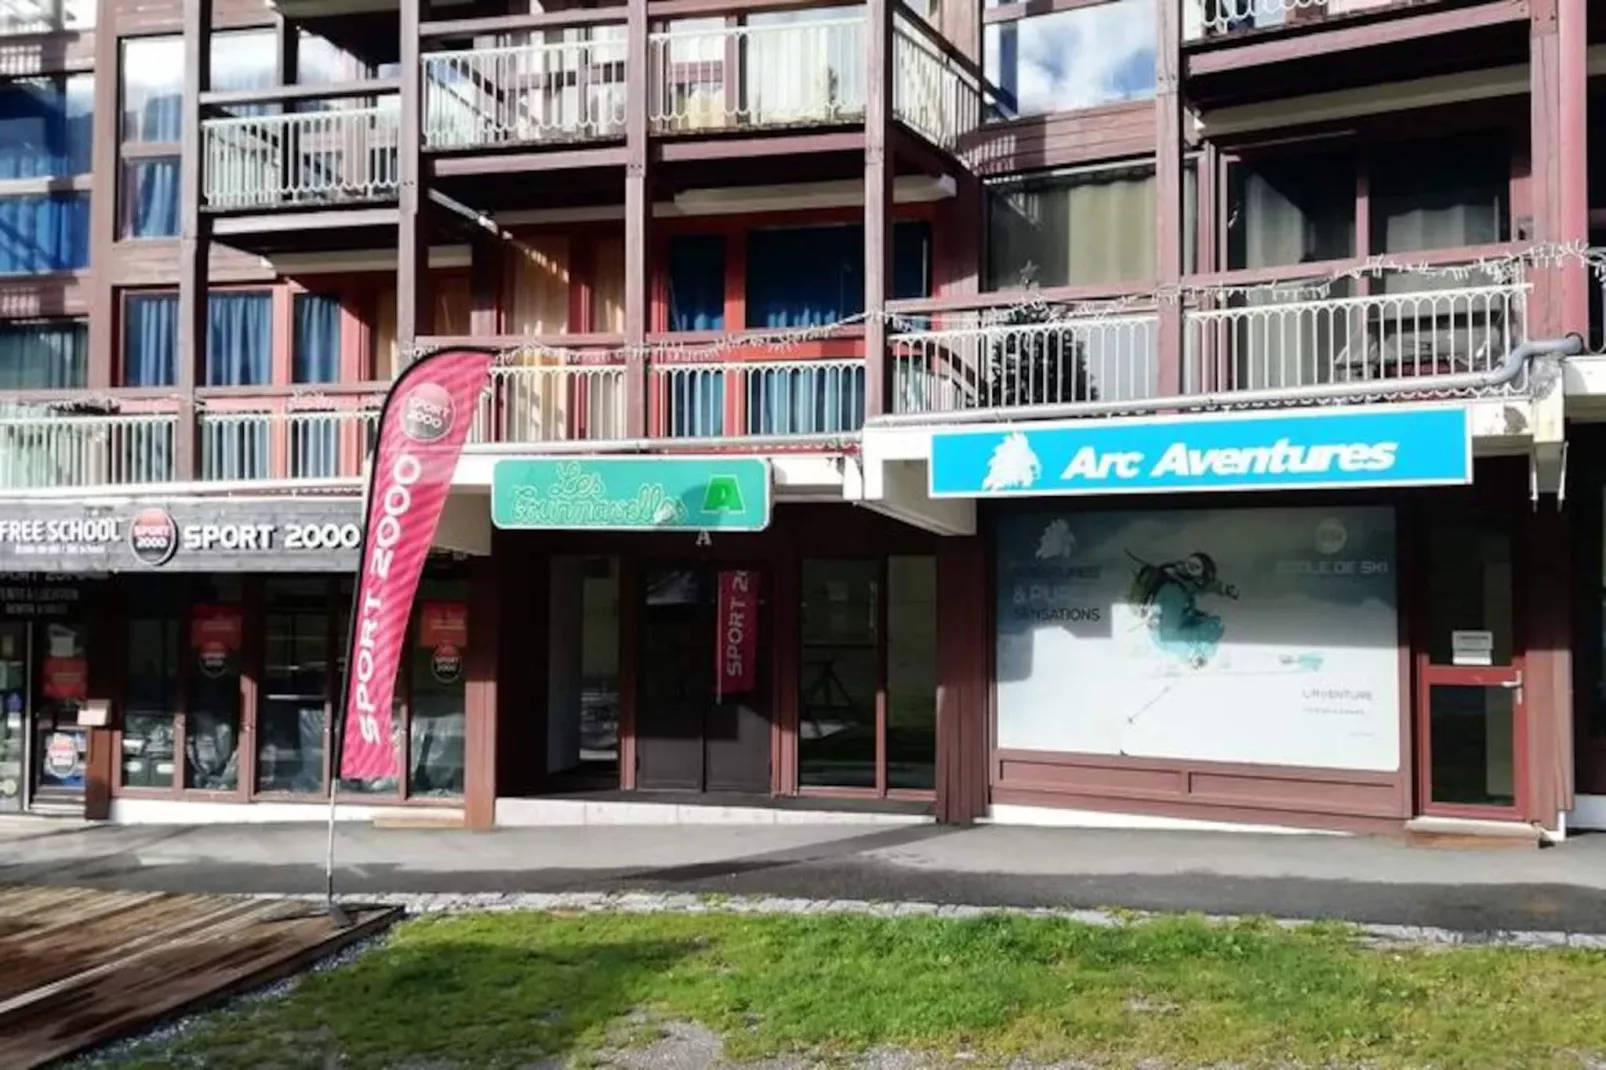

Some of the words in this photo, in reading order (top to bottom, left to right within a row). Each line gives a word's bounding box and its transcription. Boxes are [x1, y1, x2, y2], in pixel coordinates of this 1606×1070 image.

[408, 397, 450, 418] SPORT
[406, 409, 443, 429] 2000
[1060, 446, 1144, 480] Arc
[1149, 438, 1399, 477] Aventures
[0, 520, 46, 542] FREE
[47, 518, 121, 542] SCHOOL
[135, 525, 169, 537] SPORT
[183, 524, 275, 549] SPORT
[284, 523, 360, 549] 2000
[696, 529, 713, 546] A
[137, 537, 168, 548] 2000
[355, 588, 382, 745] SPORT
[370, 454, 421, 579] 2000
[726, 597, 745, 677] SPORT
